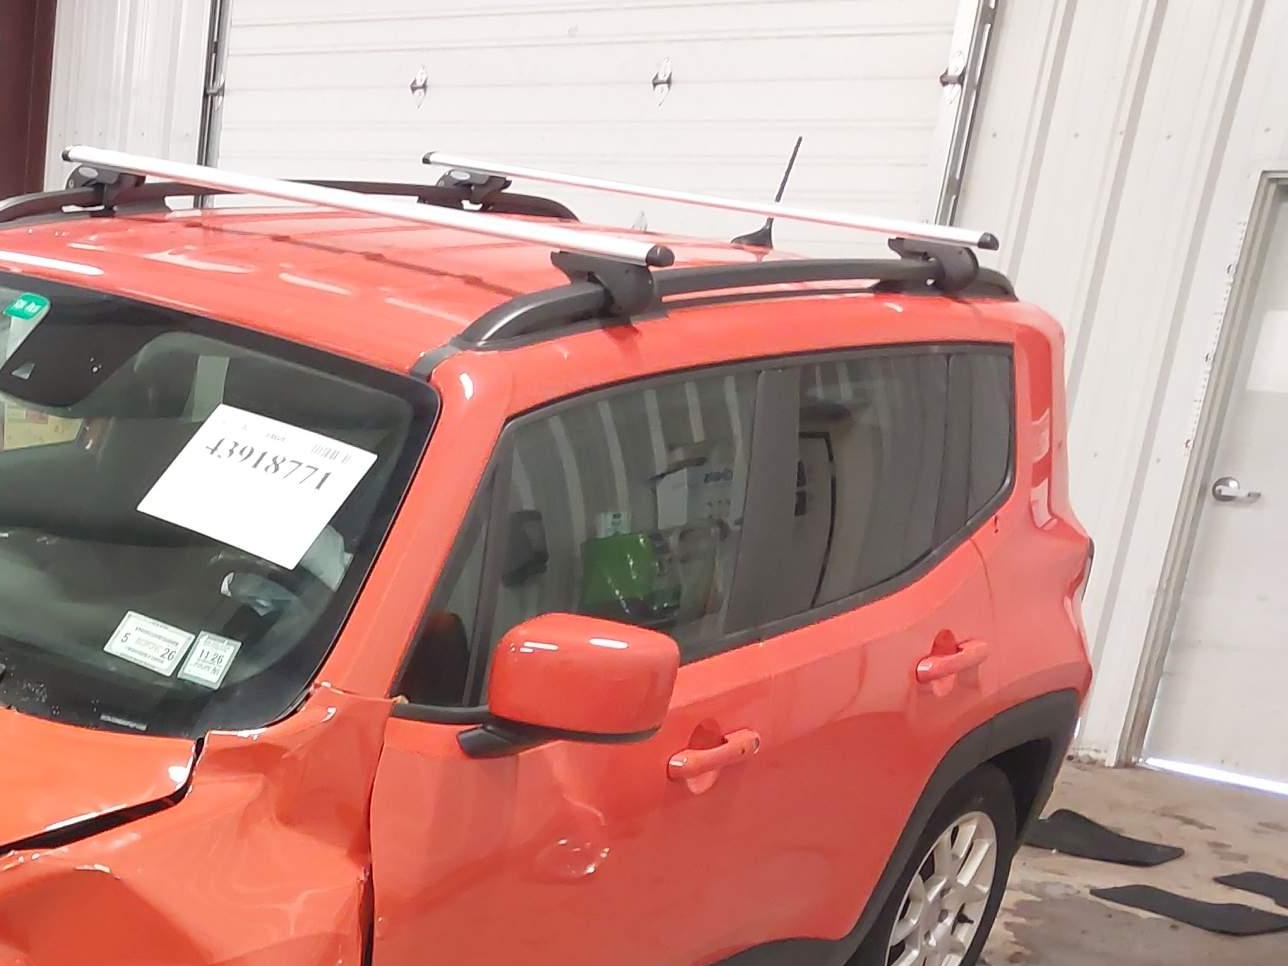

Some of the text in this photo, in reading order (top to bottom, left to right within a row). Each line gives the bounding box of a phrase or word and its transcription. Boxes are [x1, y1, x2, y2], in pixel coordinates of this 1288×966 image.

[206, 437, 332, 490] 43918771
[120, 632, 131, 644] 5
[159, 647, 177, 662] 26
